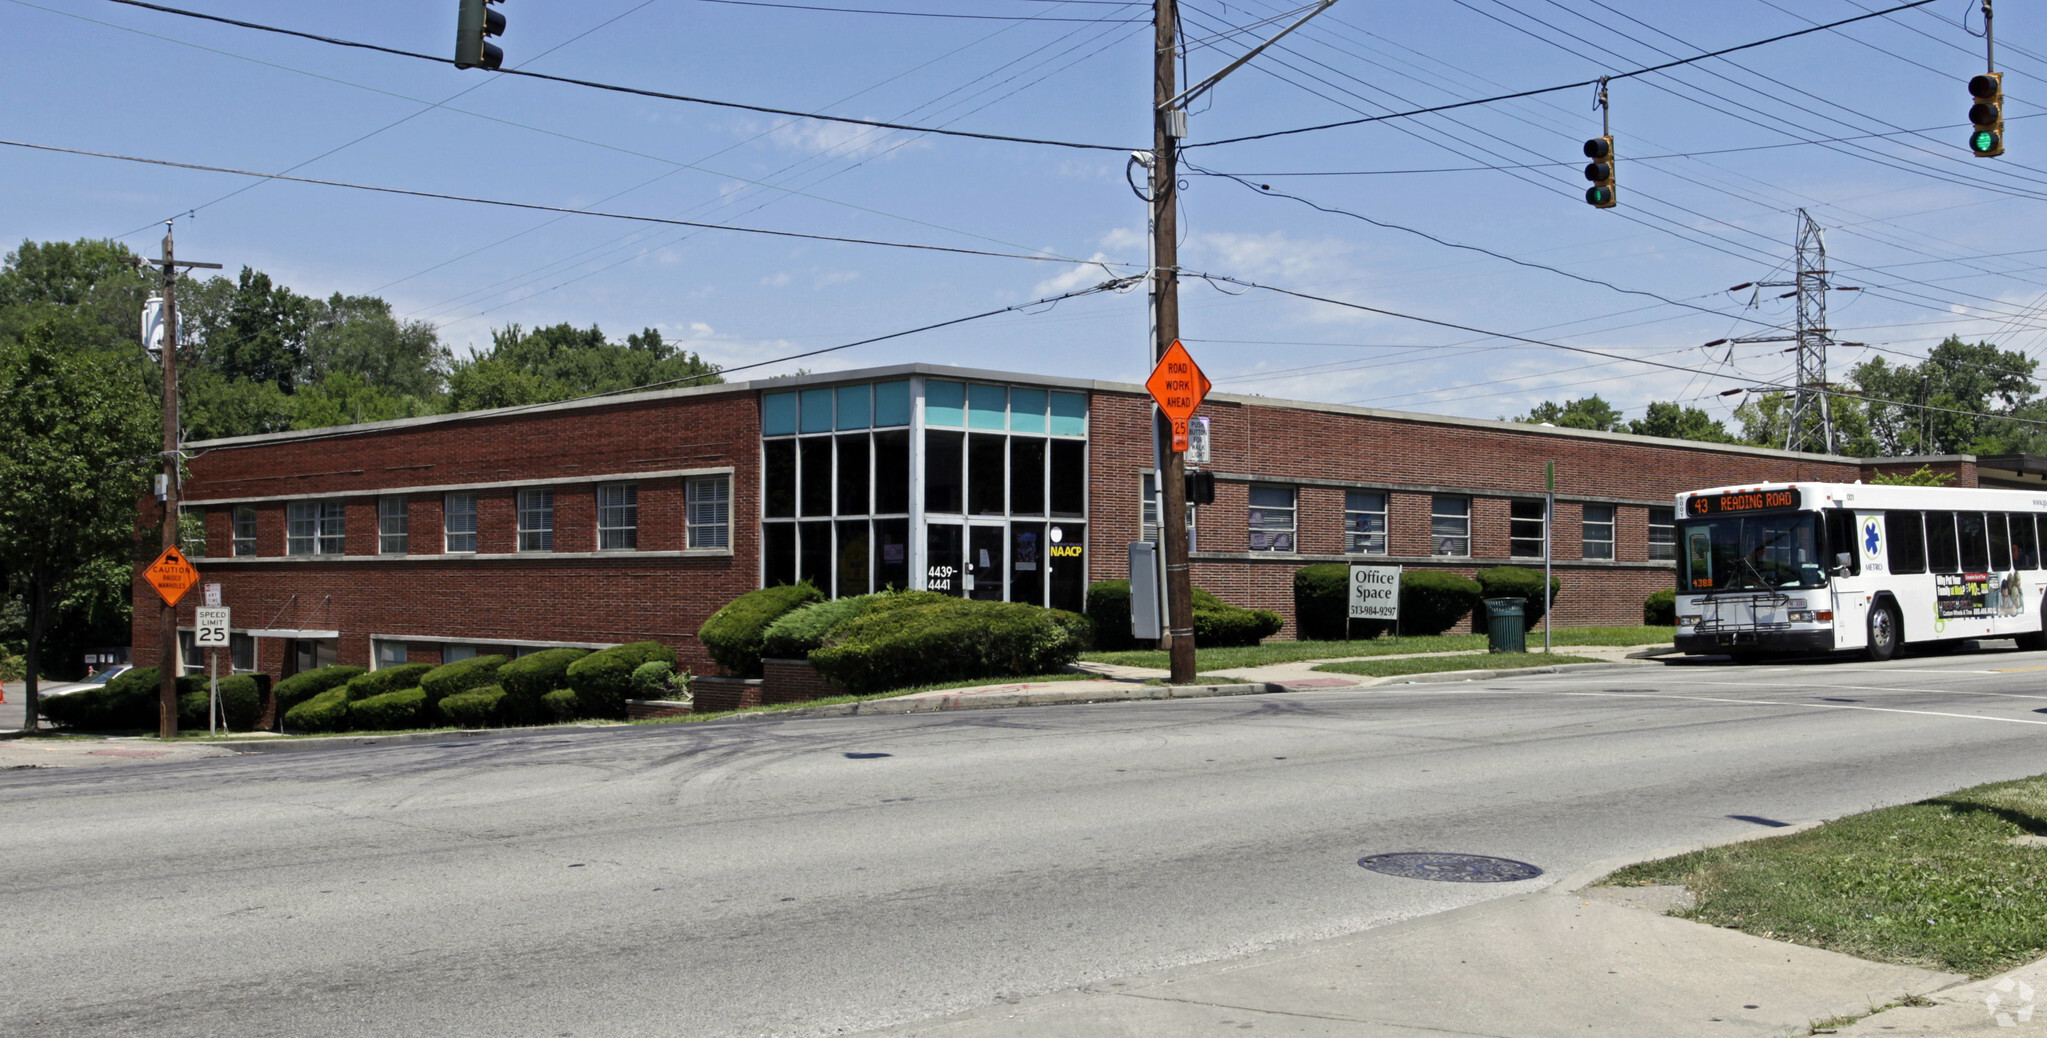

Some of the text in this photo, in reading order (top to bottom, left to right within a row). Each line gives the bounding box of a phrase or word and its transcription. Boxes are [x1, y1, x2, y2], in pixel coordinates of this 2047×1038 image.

[1168, 363, 1187, 374] ROAD
[1166, 381, 1190, 391] WORK
[1167, 397, 1190, 408] AHEAD
[1174, 422, 1186, 435] 25
[1694, 491, 1792, 514] 43 READING ROAD
[1050, 546, 1082, 557] NAACP
[928, 566, 958, 578] 4439-
[1865, 563, 1882, 571] METRO
[1356, 570, 1394, 584] Office
[928, 579, 950, 590] 4441
[1356, 585, 1392, 602] Space
[1350, 605, 1396, 616] 513-984-9297
[199, 627, 225, 642] 25
